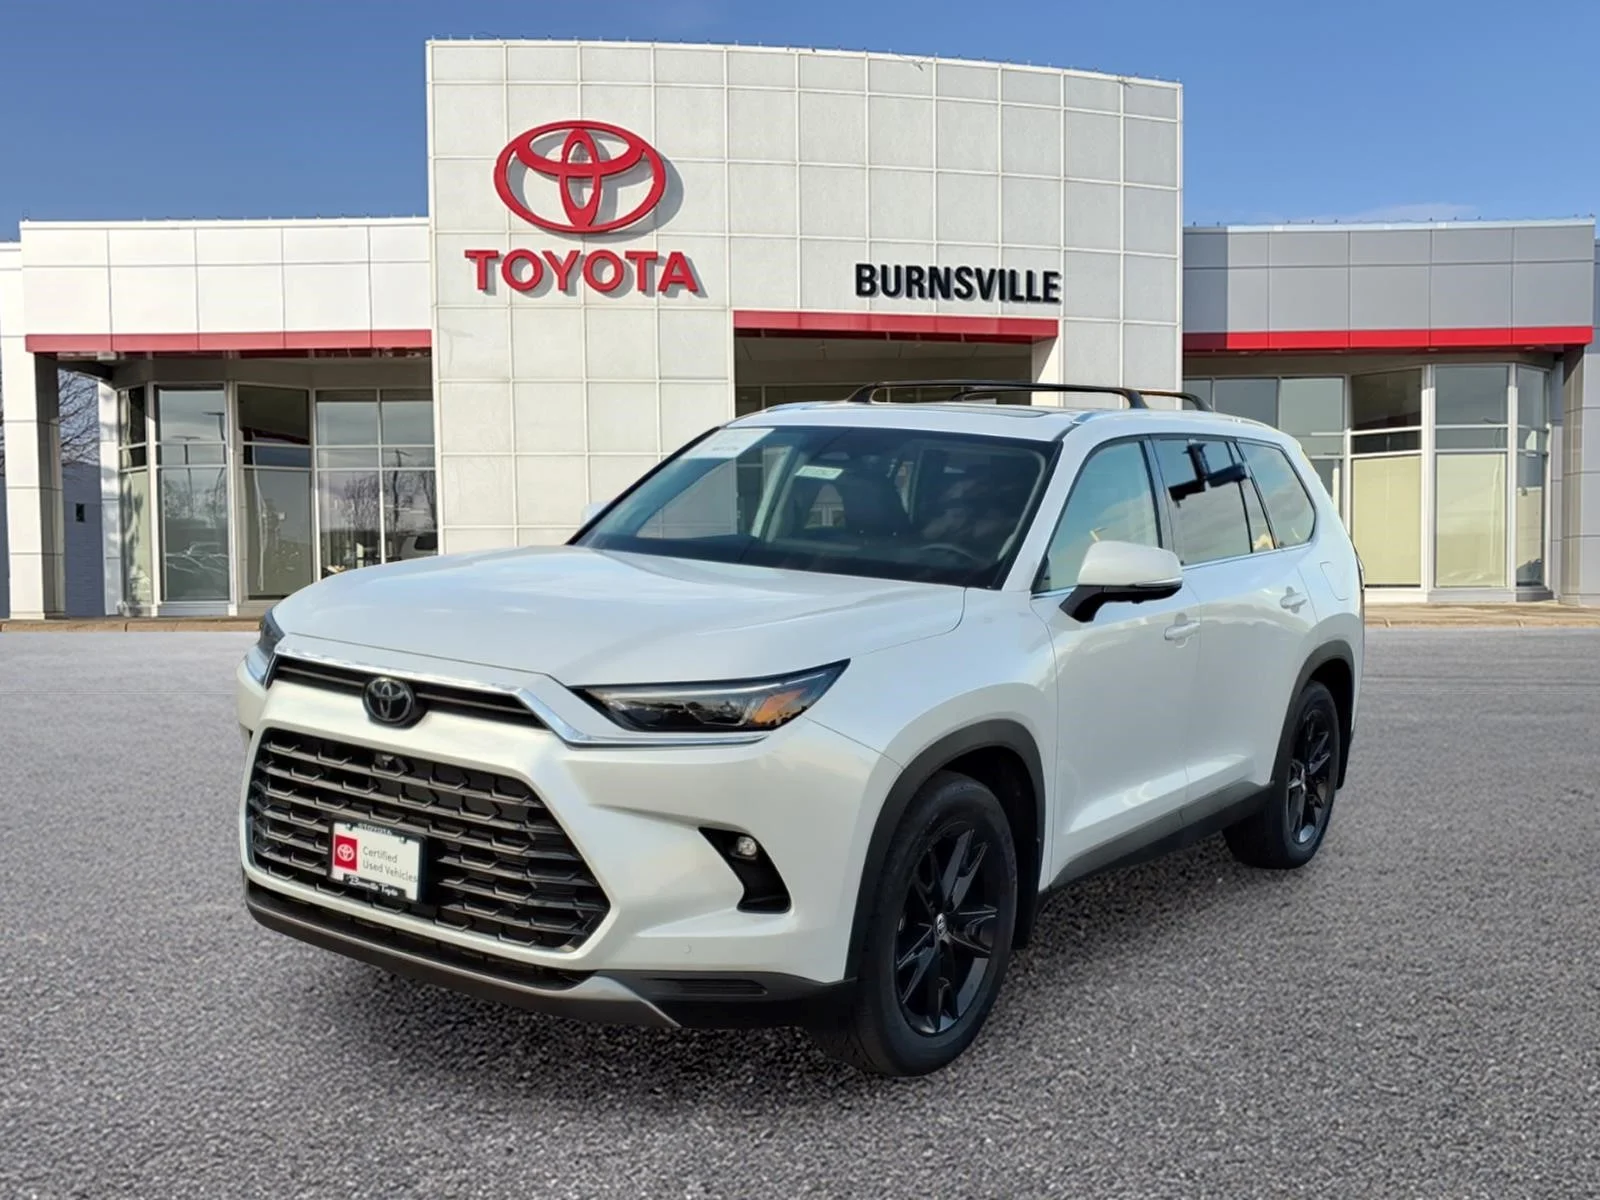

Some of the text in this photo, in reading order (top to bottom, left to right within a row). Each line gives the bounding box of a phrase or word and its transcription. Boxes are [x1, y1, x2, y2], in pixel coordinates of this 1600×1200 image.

[465, 248, 698, 292] TOYOTA
[855, 263, 1060, 302] BURNSVILLE
[362, 846, 398, 863] Certified
[362, 859, 418, 882] Used Vehicles
